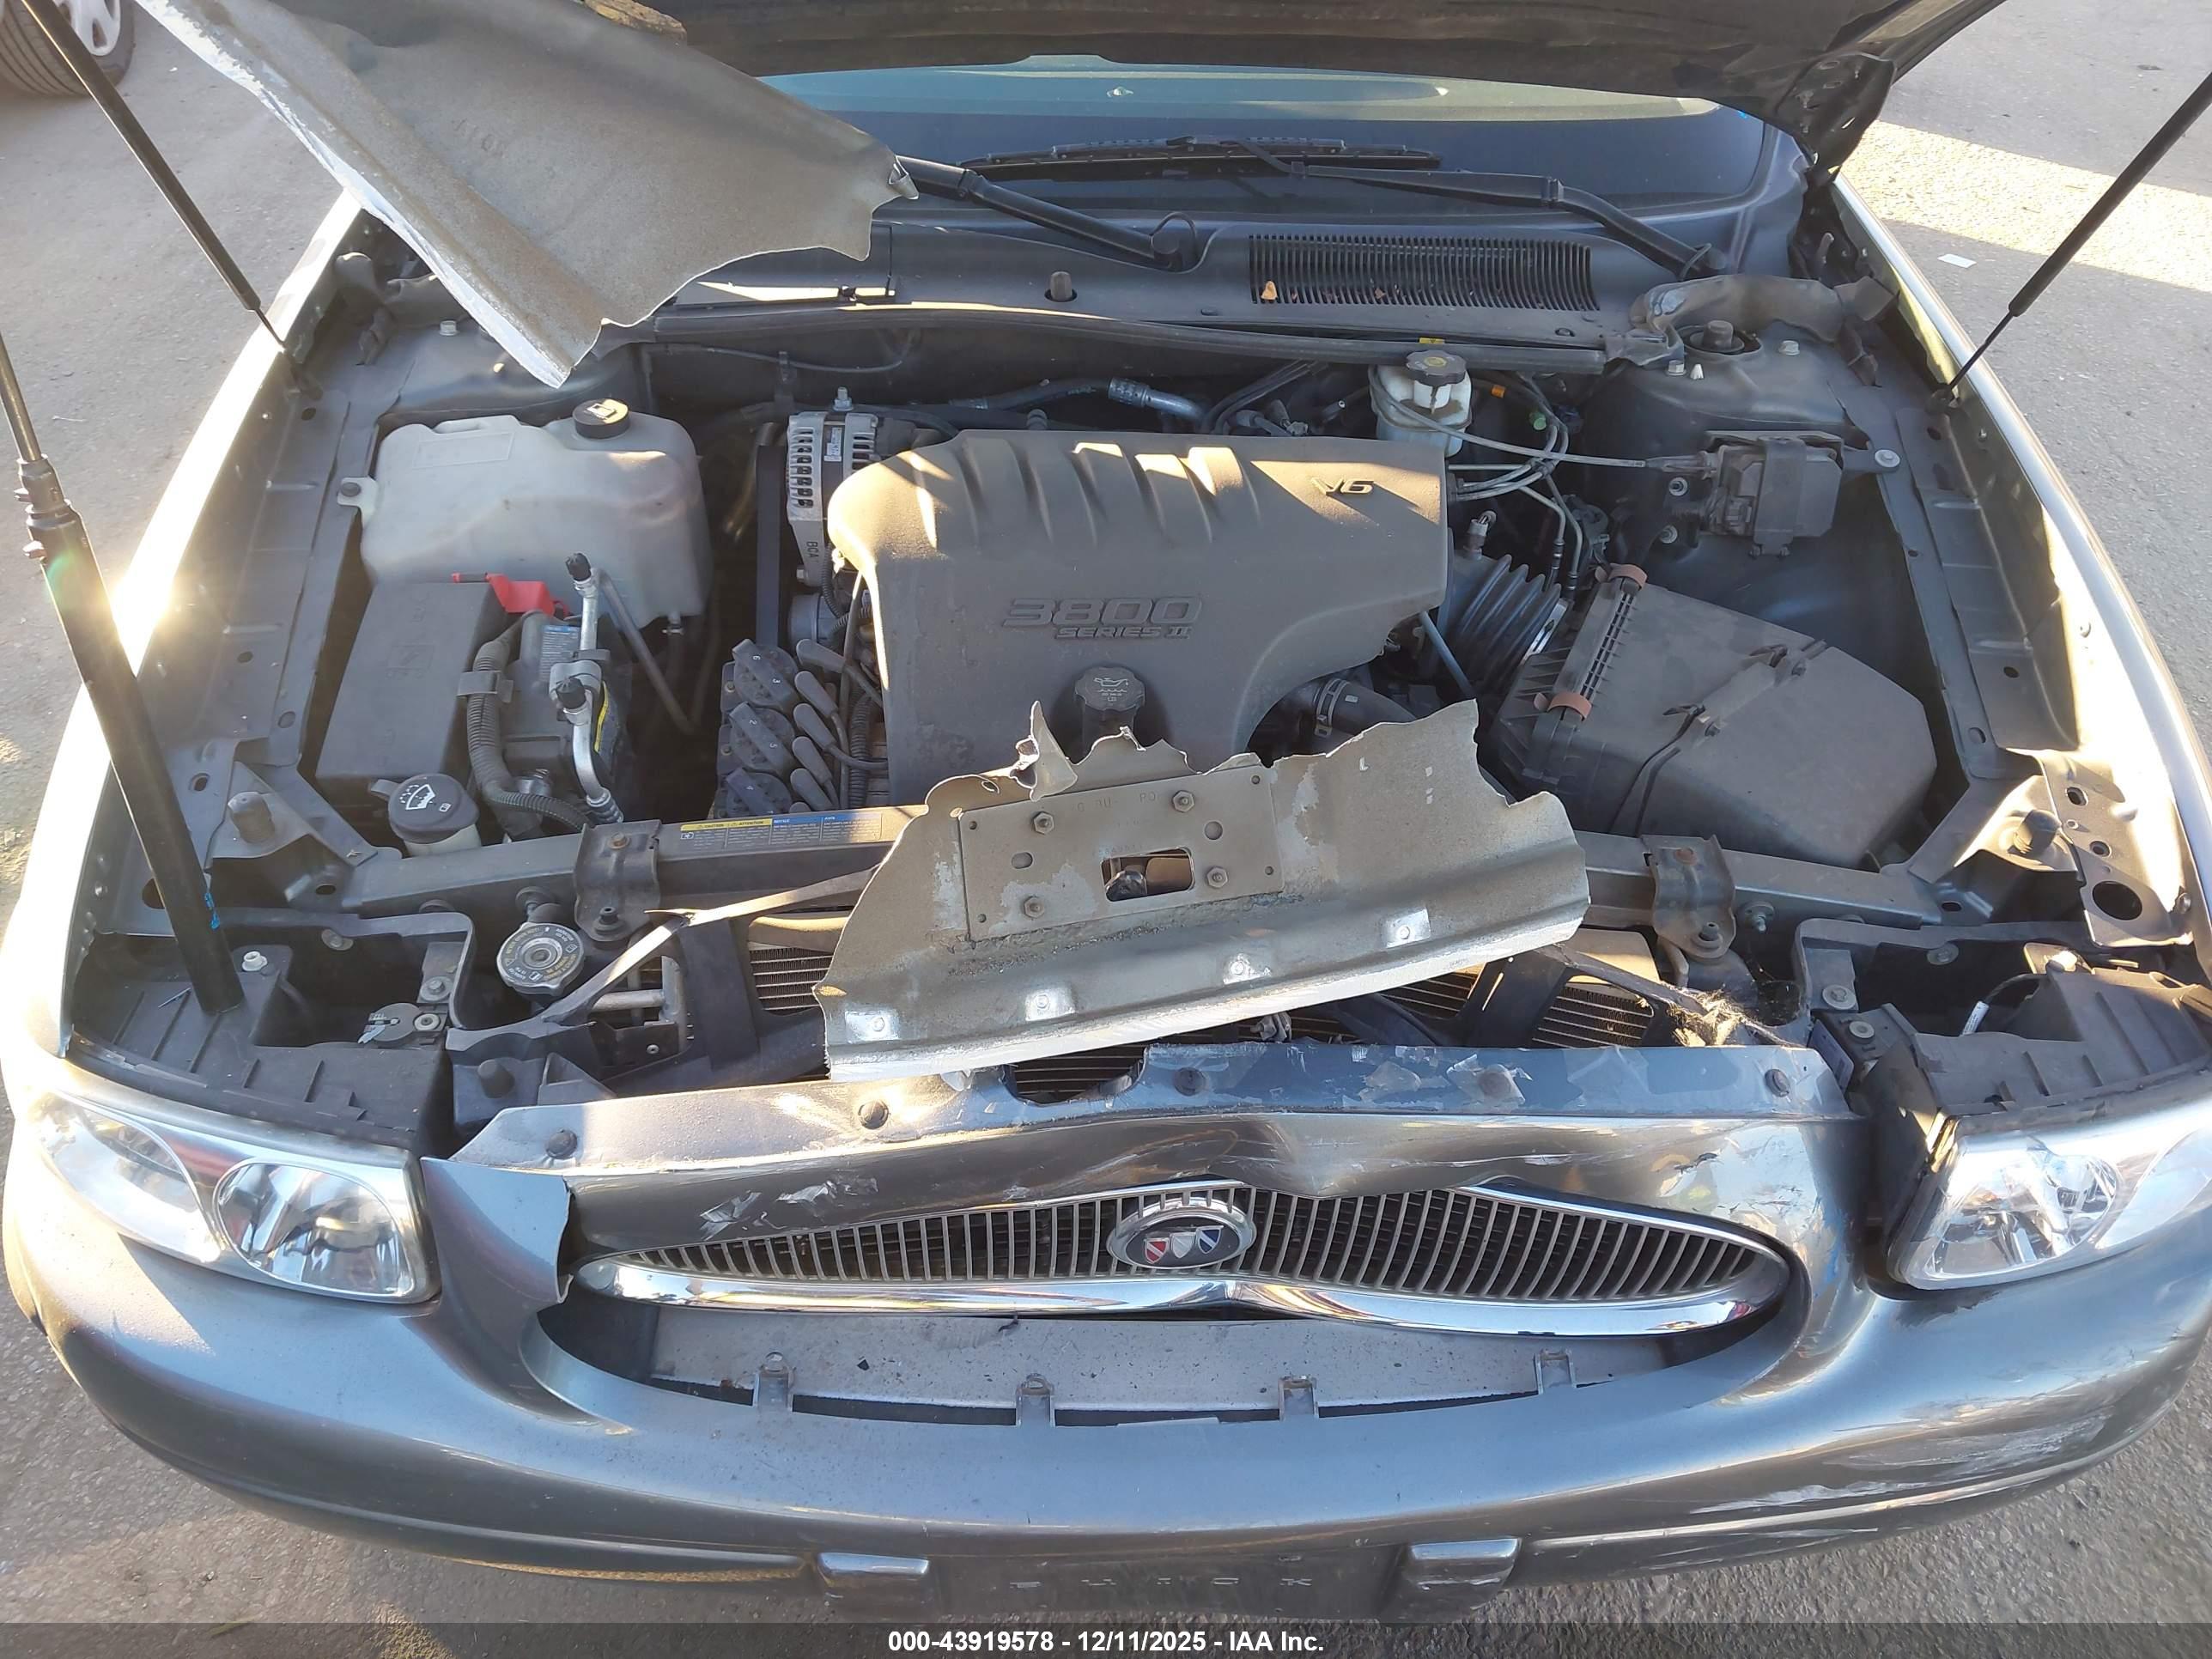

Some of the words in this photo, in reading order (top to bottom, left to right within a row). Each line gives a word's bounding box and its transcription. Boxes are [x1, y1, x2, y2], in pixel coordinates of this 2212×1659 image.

[1310, 477, 1375, 495] V6
[805, 540, 819, 558] BCA
[1002, 597, 1202, 627] 3800
[1055, 626, 1162, 640] SERIES
[1164, 626, 1193, 640] II
